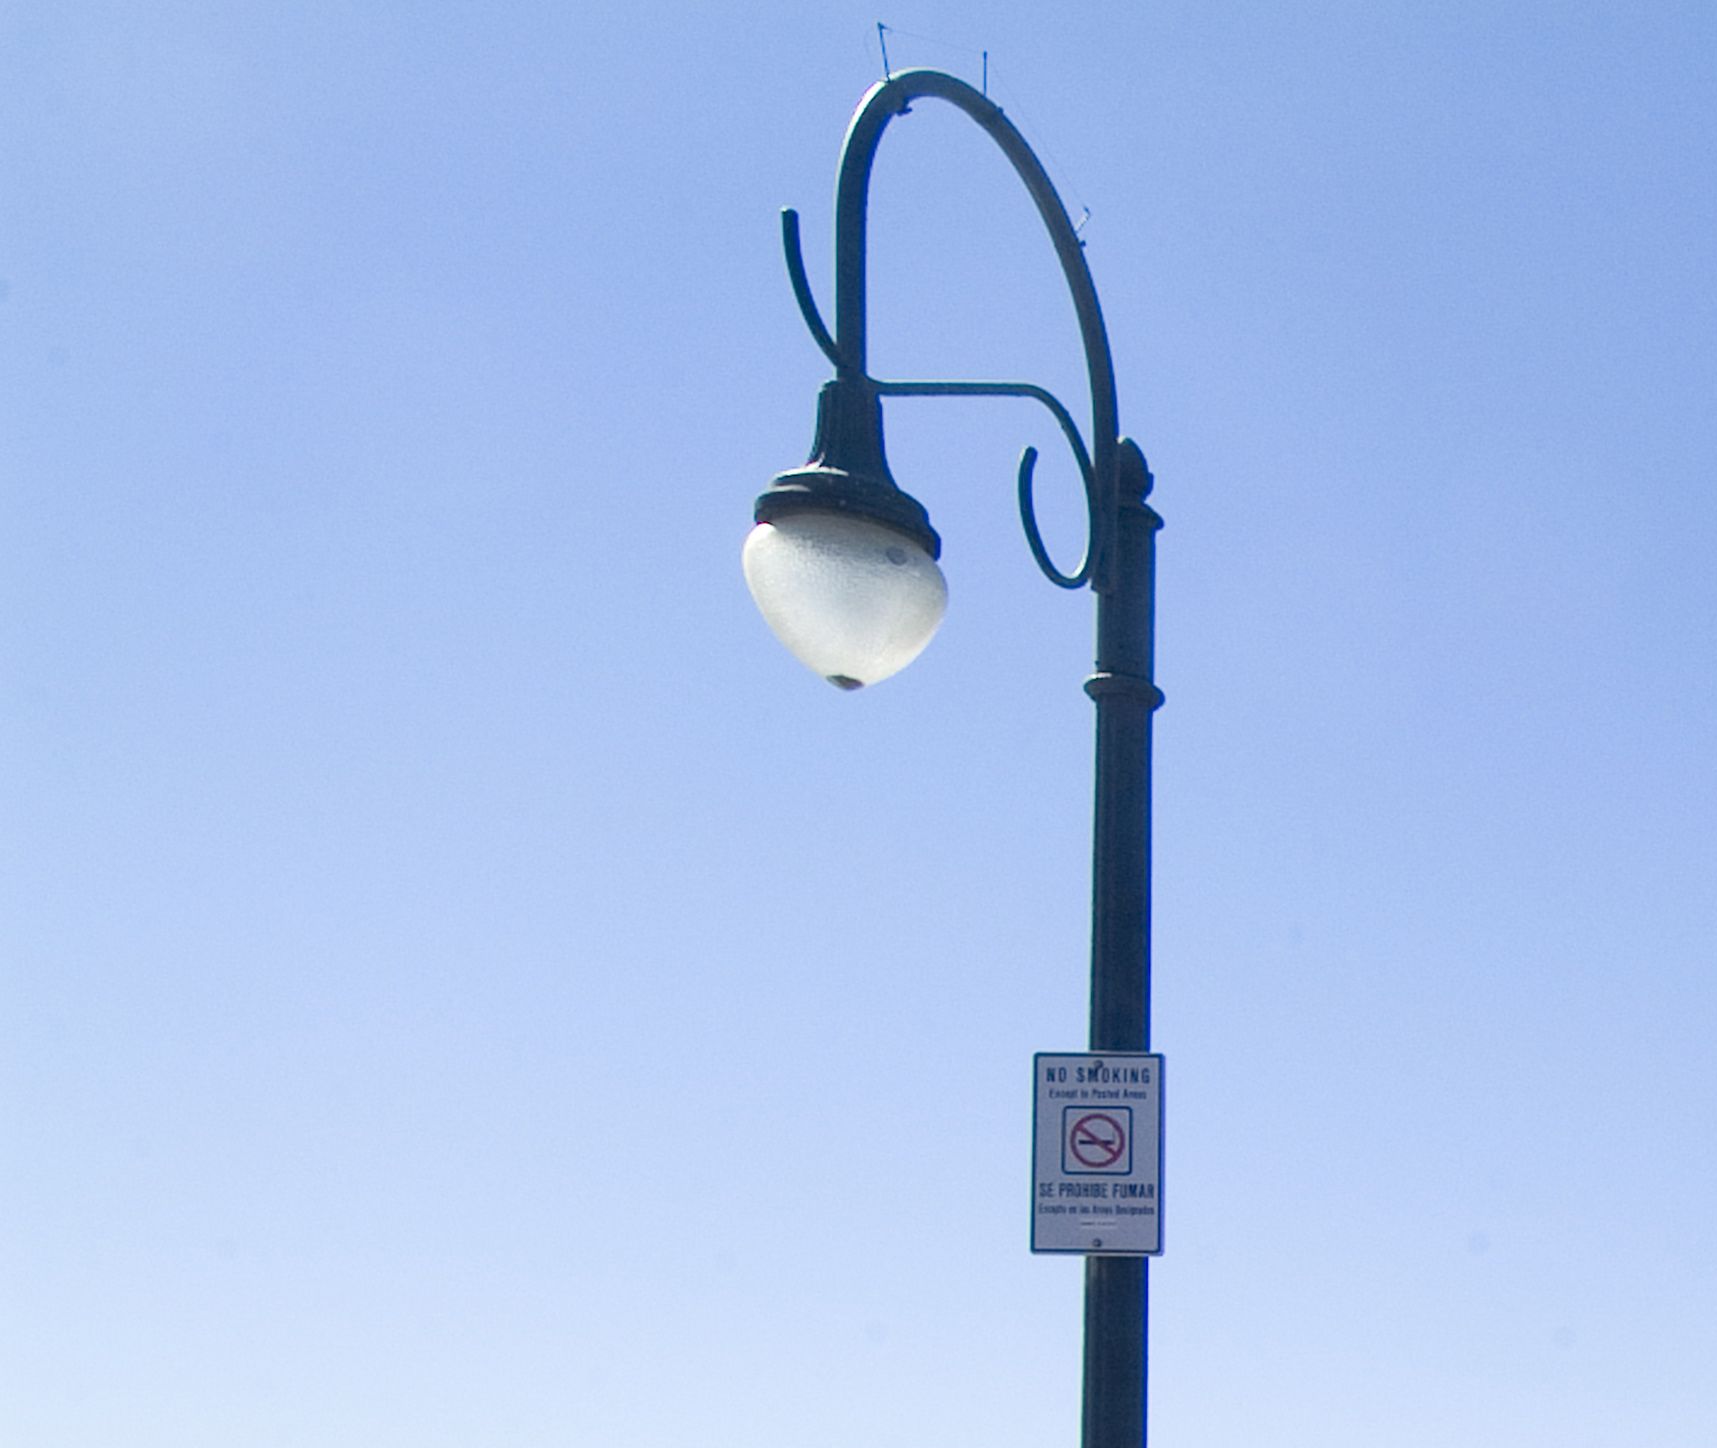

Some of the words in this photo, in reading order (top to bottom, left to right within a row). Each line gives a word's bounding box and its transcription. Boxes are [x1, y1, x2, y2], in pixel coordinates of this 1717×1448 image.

[1046, 1066, 1068, 1083] NO
[1076, 1066, 1151, 1084] SMOKING
[1039, 1182, 1054, 1198] SE
[1058, 1182, 1108, 1199] PROHIBE
[1112, 1183, 1155, 1199] FUMAR
